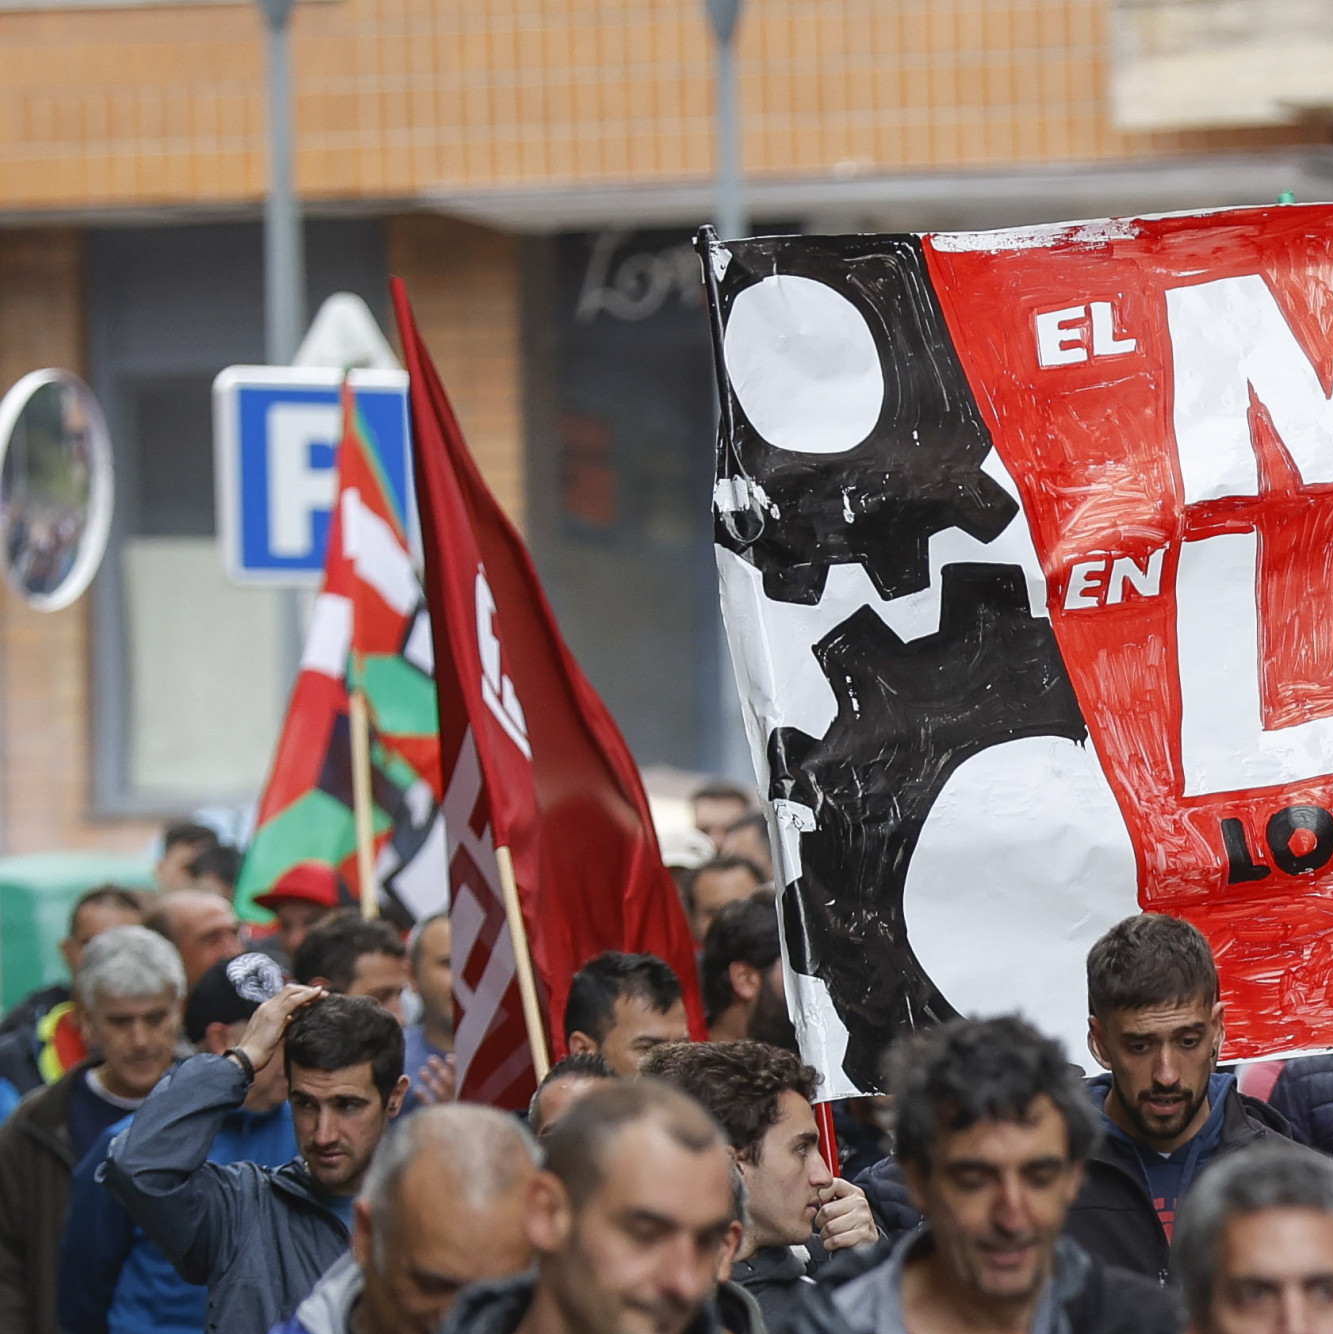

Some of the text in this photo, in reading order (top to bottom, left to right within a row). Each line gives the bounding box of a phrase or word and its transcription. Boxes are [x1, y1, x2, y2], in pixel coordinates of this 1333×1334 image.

[1035, 299, 1137, 368] EL
[266, 401, 342, 558] P
[1063, 549, 1168, 612] EN
